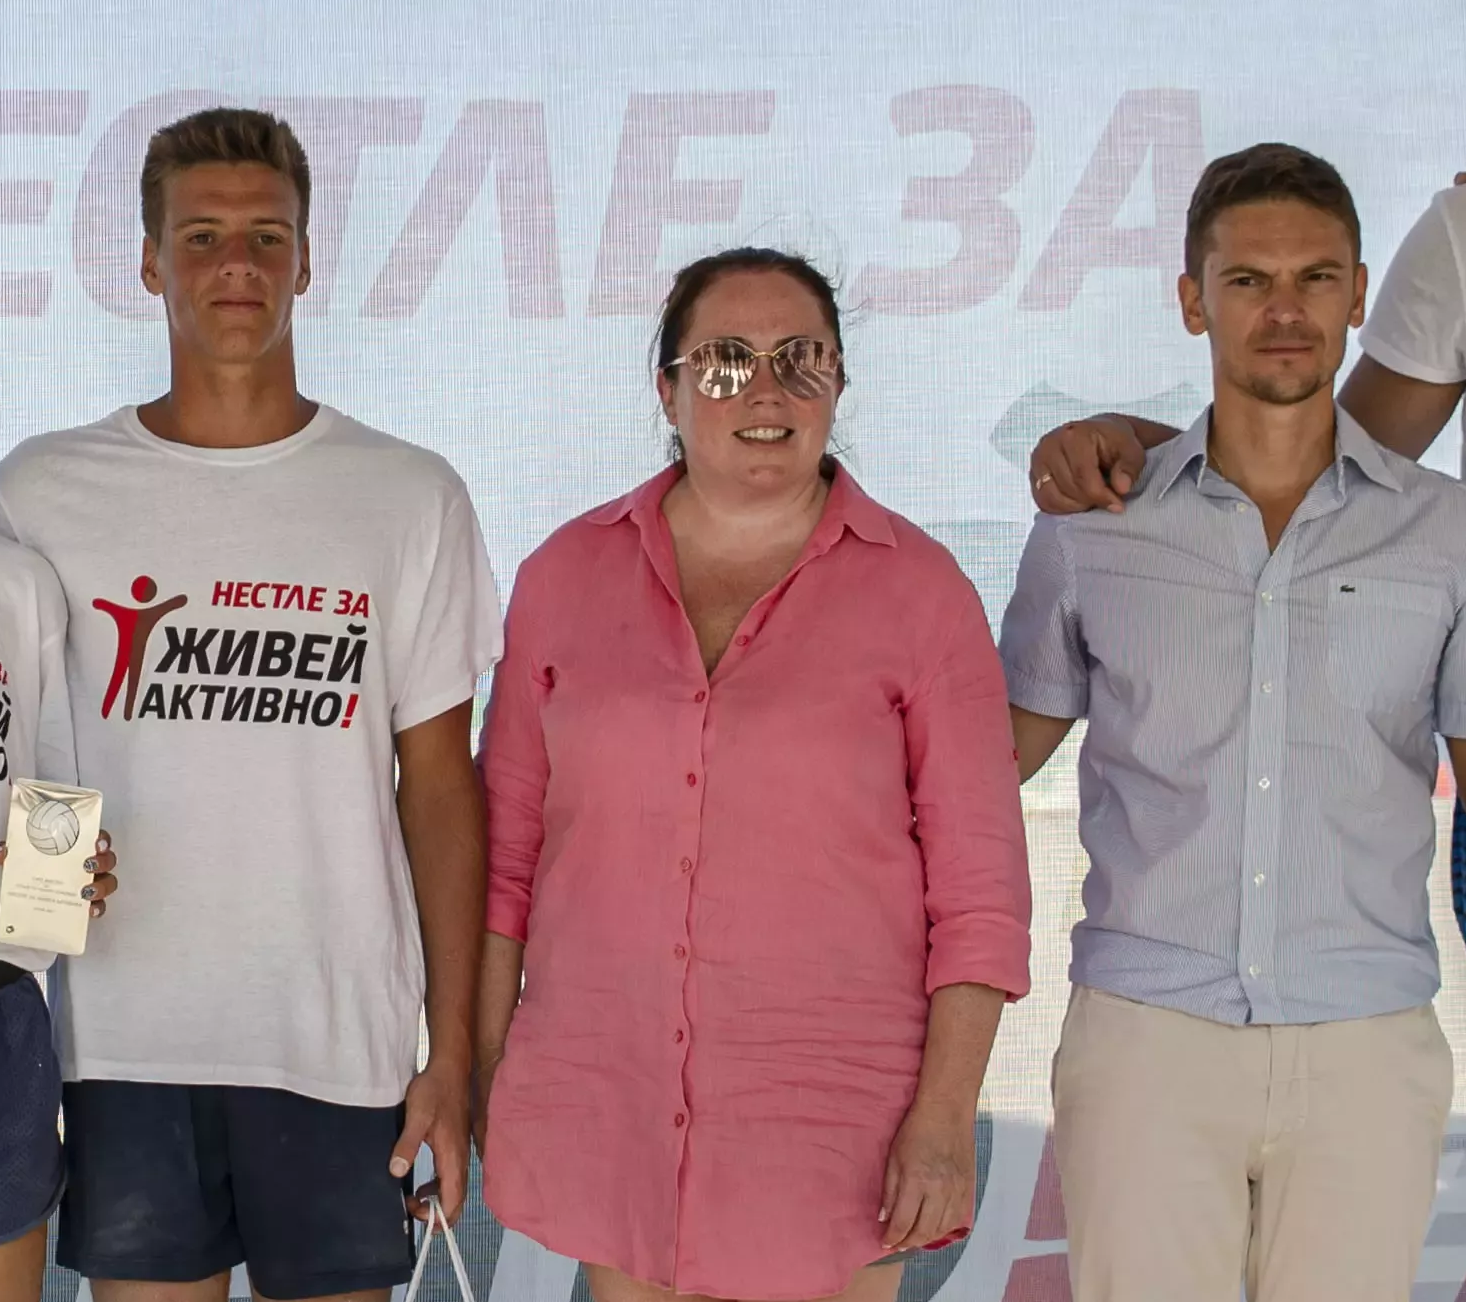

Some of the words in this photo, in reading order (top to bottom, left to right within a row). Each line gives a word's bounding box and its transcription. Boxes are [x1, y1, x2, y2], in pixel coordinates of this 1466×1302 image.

[850, 84, 1208, 321] ЗА
[211, 580, 328, 612] НЕСТЛЕ
[333, 588, 370, 619] ЗА
[153, 623, 369, 684] ЖИВЕЙ
[137, 682, 360, 729] АКТИВНО!
